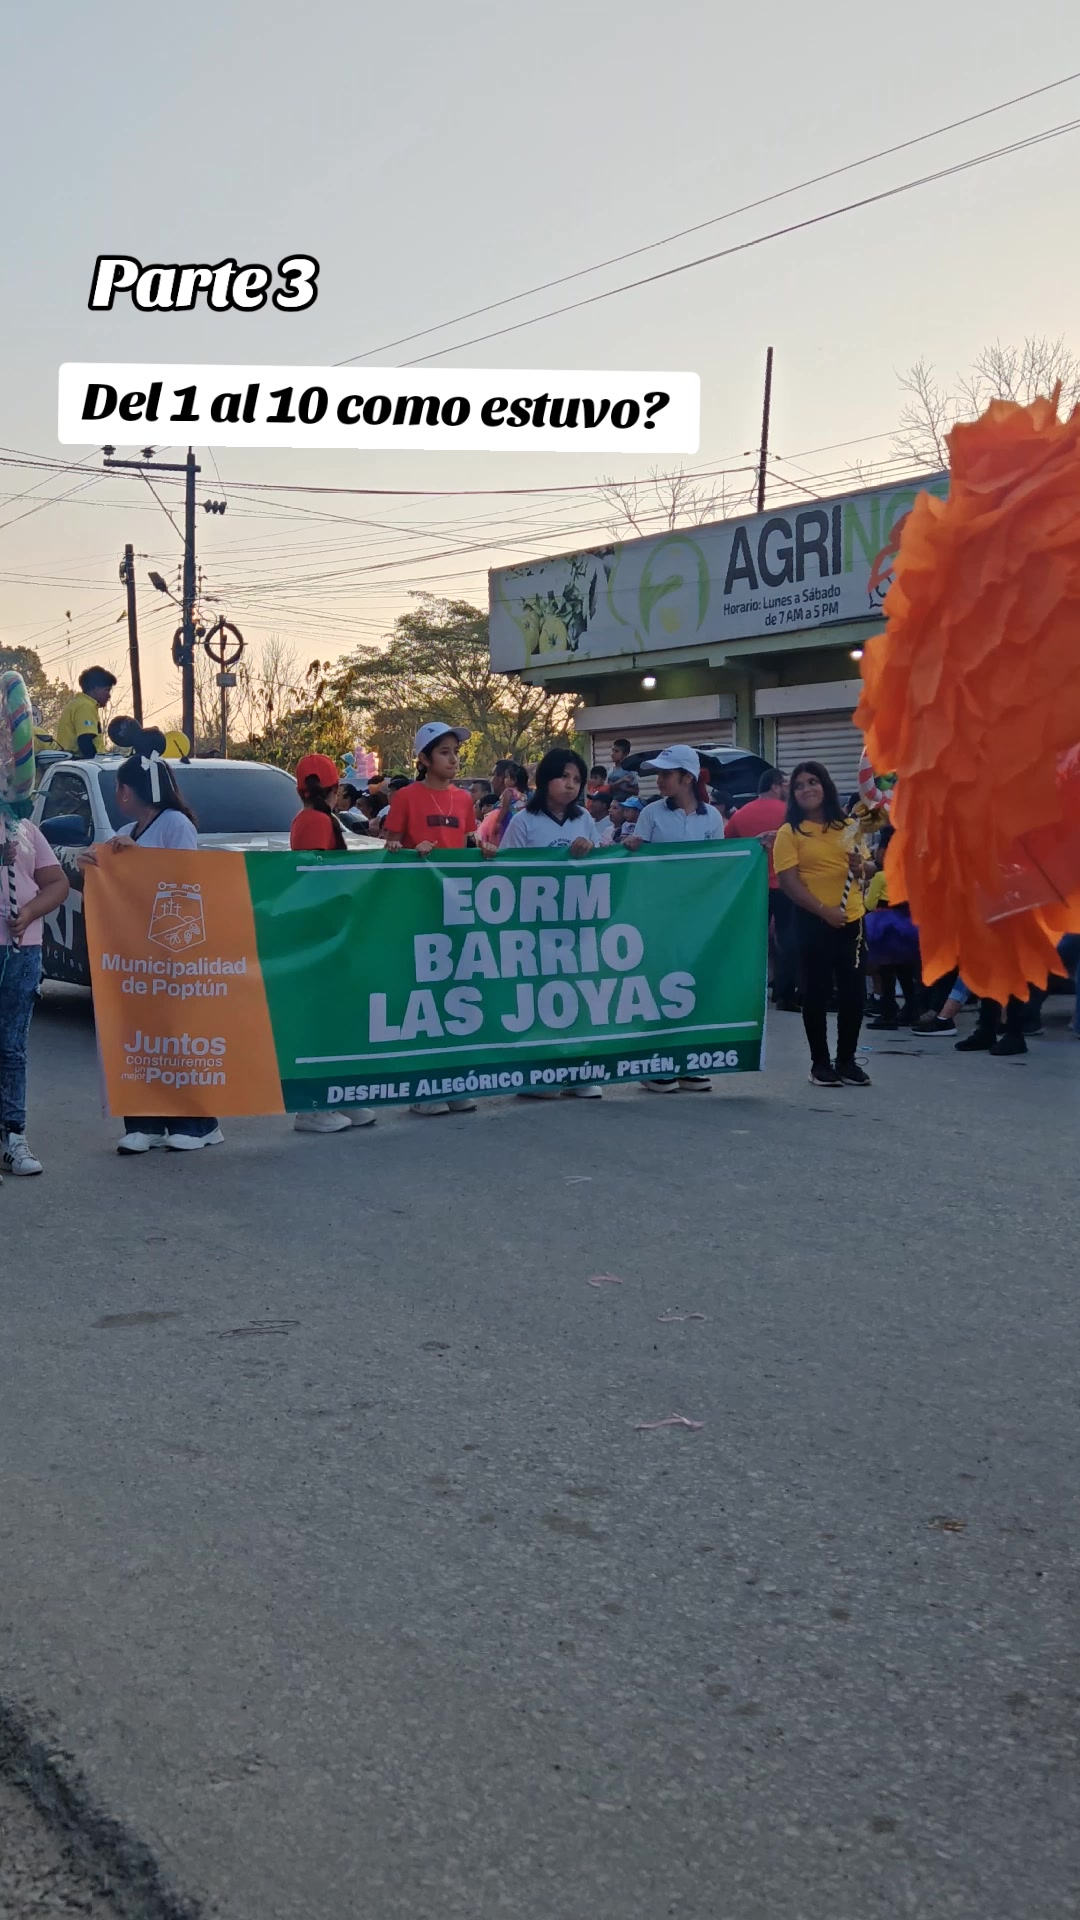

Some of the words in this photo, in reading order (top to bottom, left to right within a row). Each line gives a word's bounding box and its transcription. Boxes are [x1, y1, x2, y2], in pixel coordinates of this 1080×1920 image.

[723, 599, 761, 616] Horario:
[763, 597, 792, 610] Lunes
[794, 594, 800, 603] a
[802, 584, 841, 603] Sábado
[765, 613, 776, 626] de
[779, 611, 785, 625] 7
[786, 608, 803, 623] AM
[805, 609, 811, 619] a
[813, 605, 820, 618] 5
[822, 601, 839, 617] PM
[442, 872, 611, 926] EORM
[101, 953, 247, 979] Municipalidad
[414, 924, 644, 982] BARRIO
[121, 976, 148, 995] de
[152, 978, 228, 1000] Poptún
[368, 986, 483, 1043] LAS
[501, 971, 696, 1033] JOYAS
[124, 1030, 226, 1055] Juntos
[126, 1055, 223, 1067] construiremos
[121, 1072, 146, 1080] mejor
[146, 1067, 226, 1089] Poptún
[327, 1082, 411, 1103] DESFILE
[415, 1070, 523, 1097] ALEGÓRICO
[530, 1061, 611, 1085] POPTÚN,
[617, 1053, 681, 1076] PETÉN,
[686, 1050, 739, 1070] 2026
